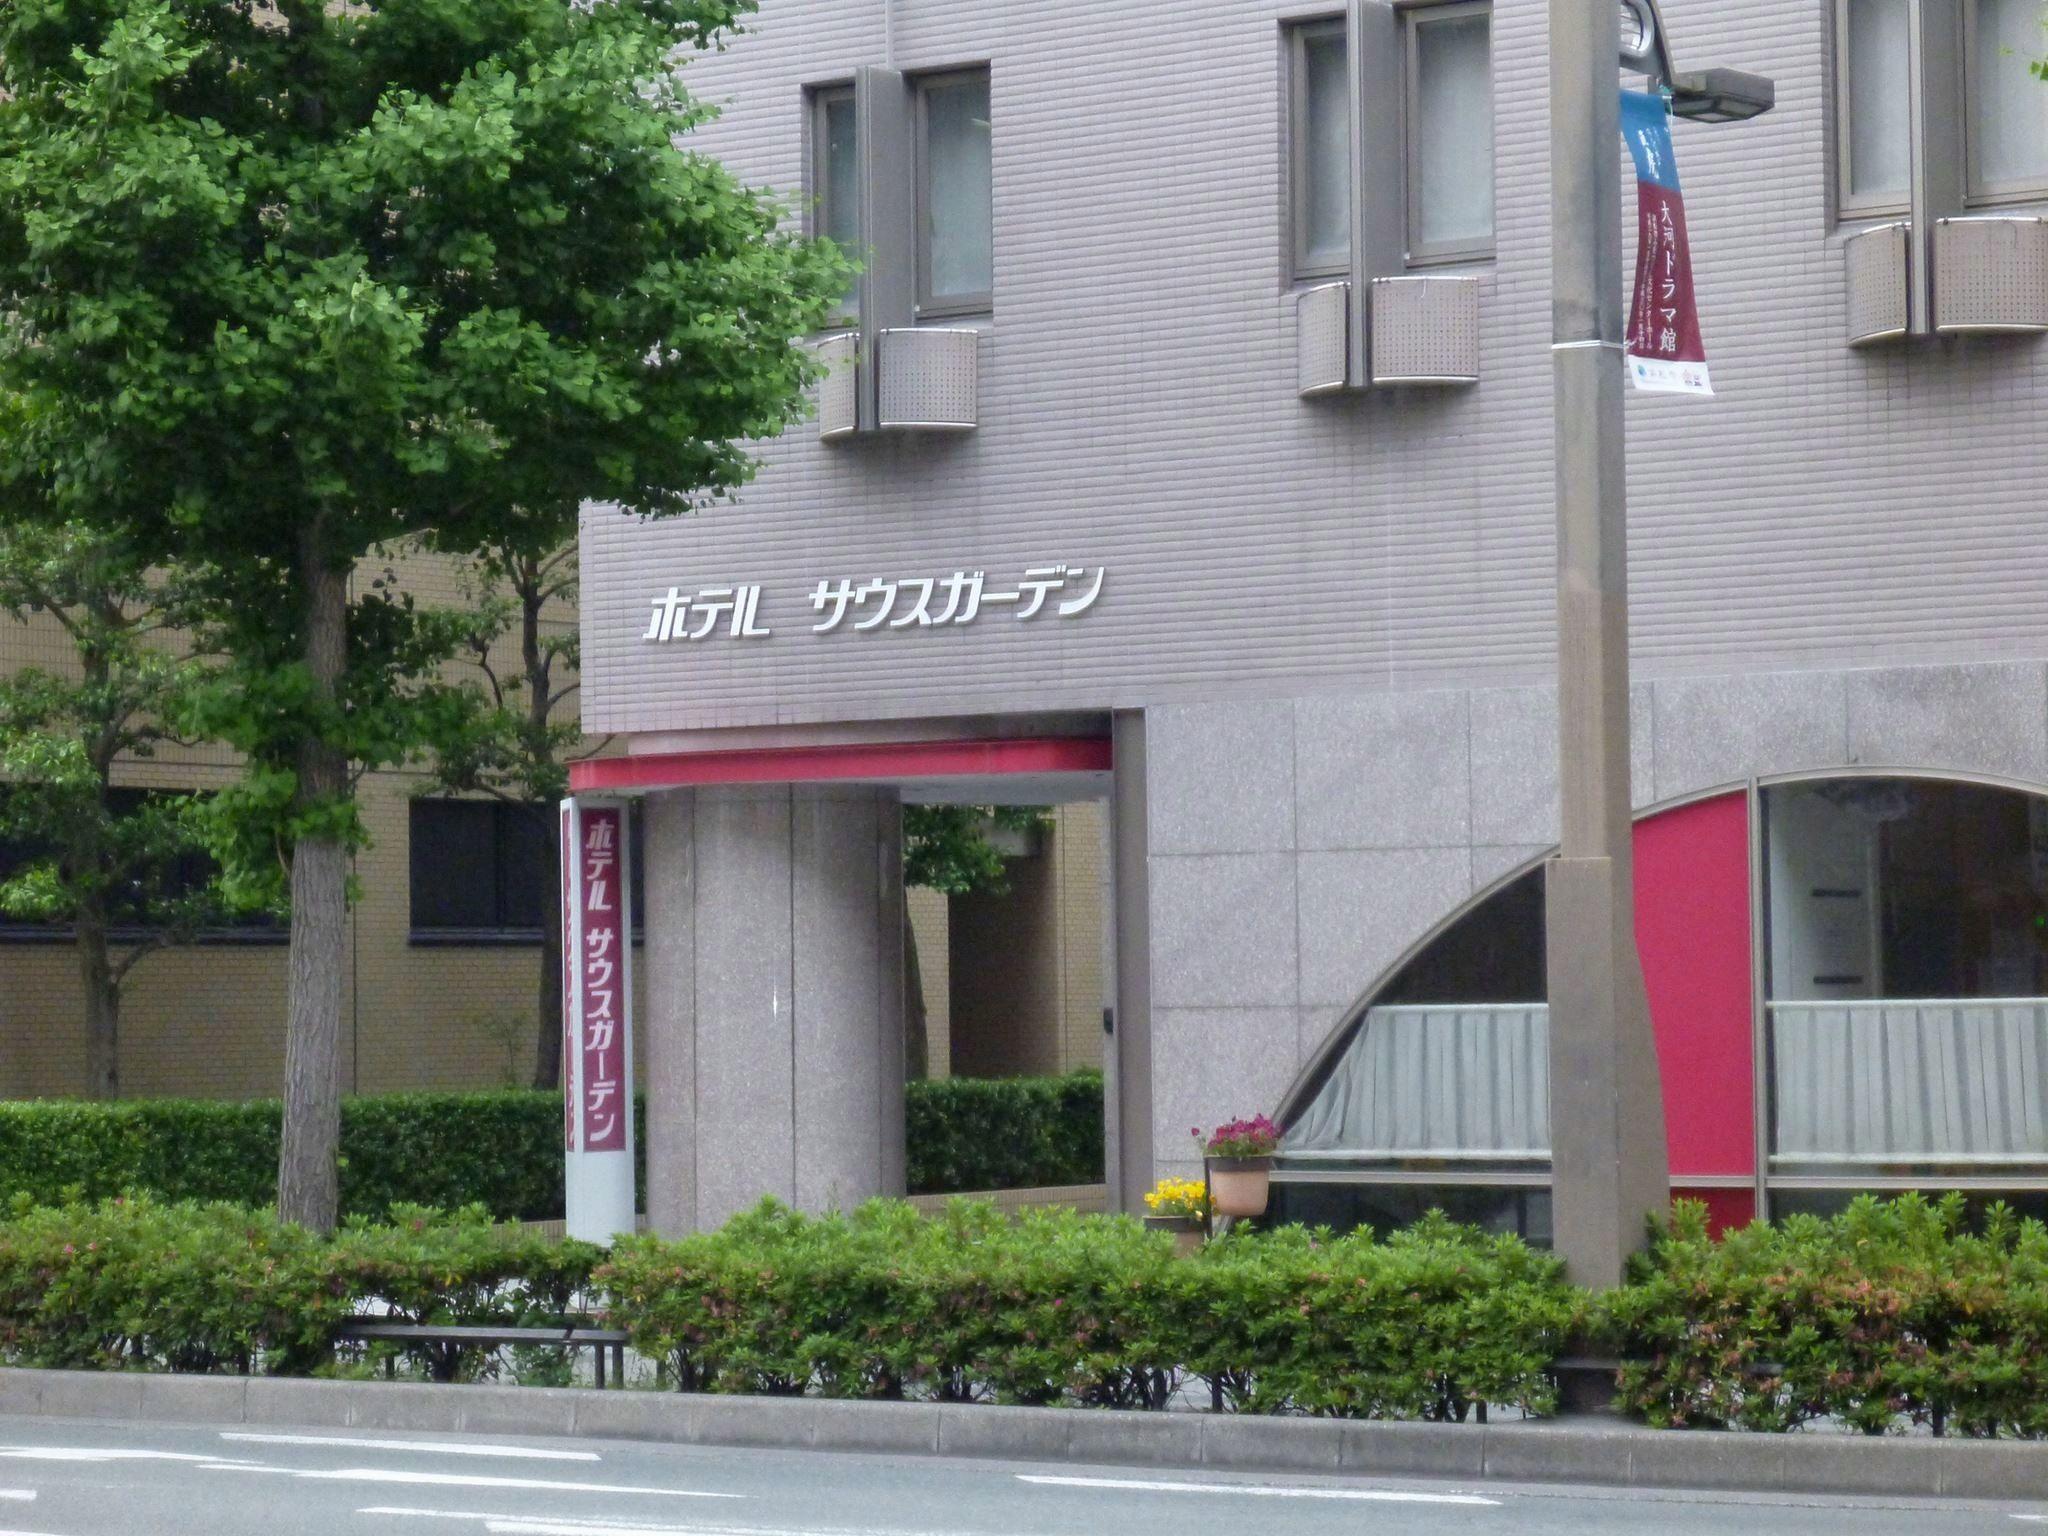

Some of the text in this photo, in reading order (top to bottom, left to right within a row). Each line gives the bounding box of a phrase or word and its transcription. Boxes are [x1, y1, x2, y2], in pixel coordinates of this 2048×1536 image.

[1660, 199, 1677, 352] 大河ドラマ館
[643, 565, 1105, 641] ホテル サウスガーデン
[585, 818, 616, 1143] ホテル サウスガーデン
